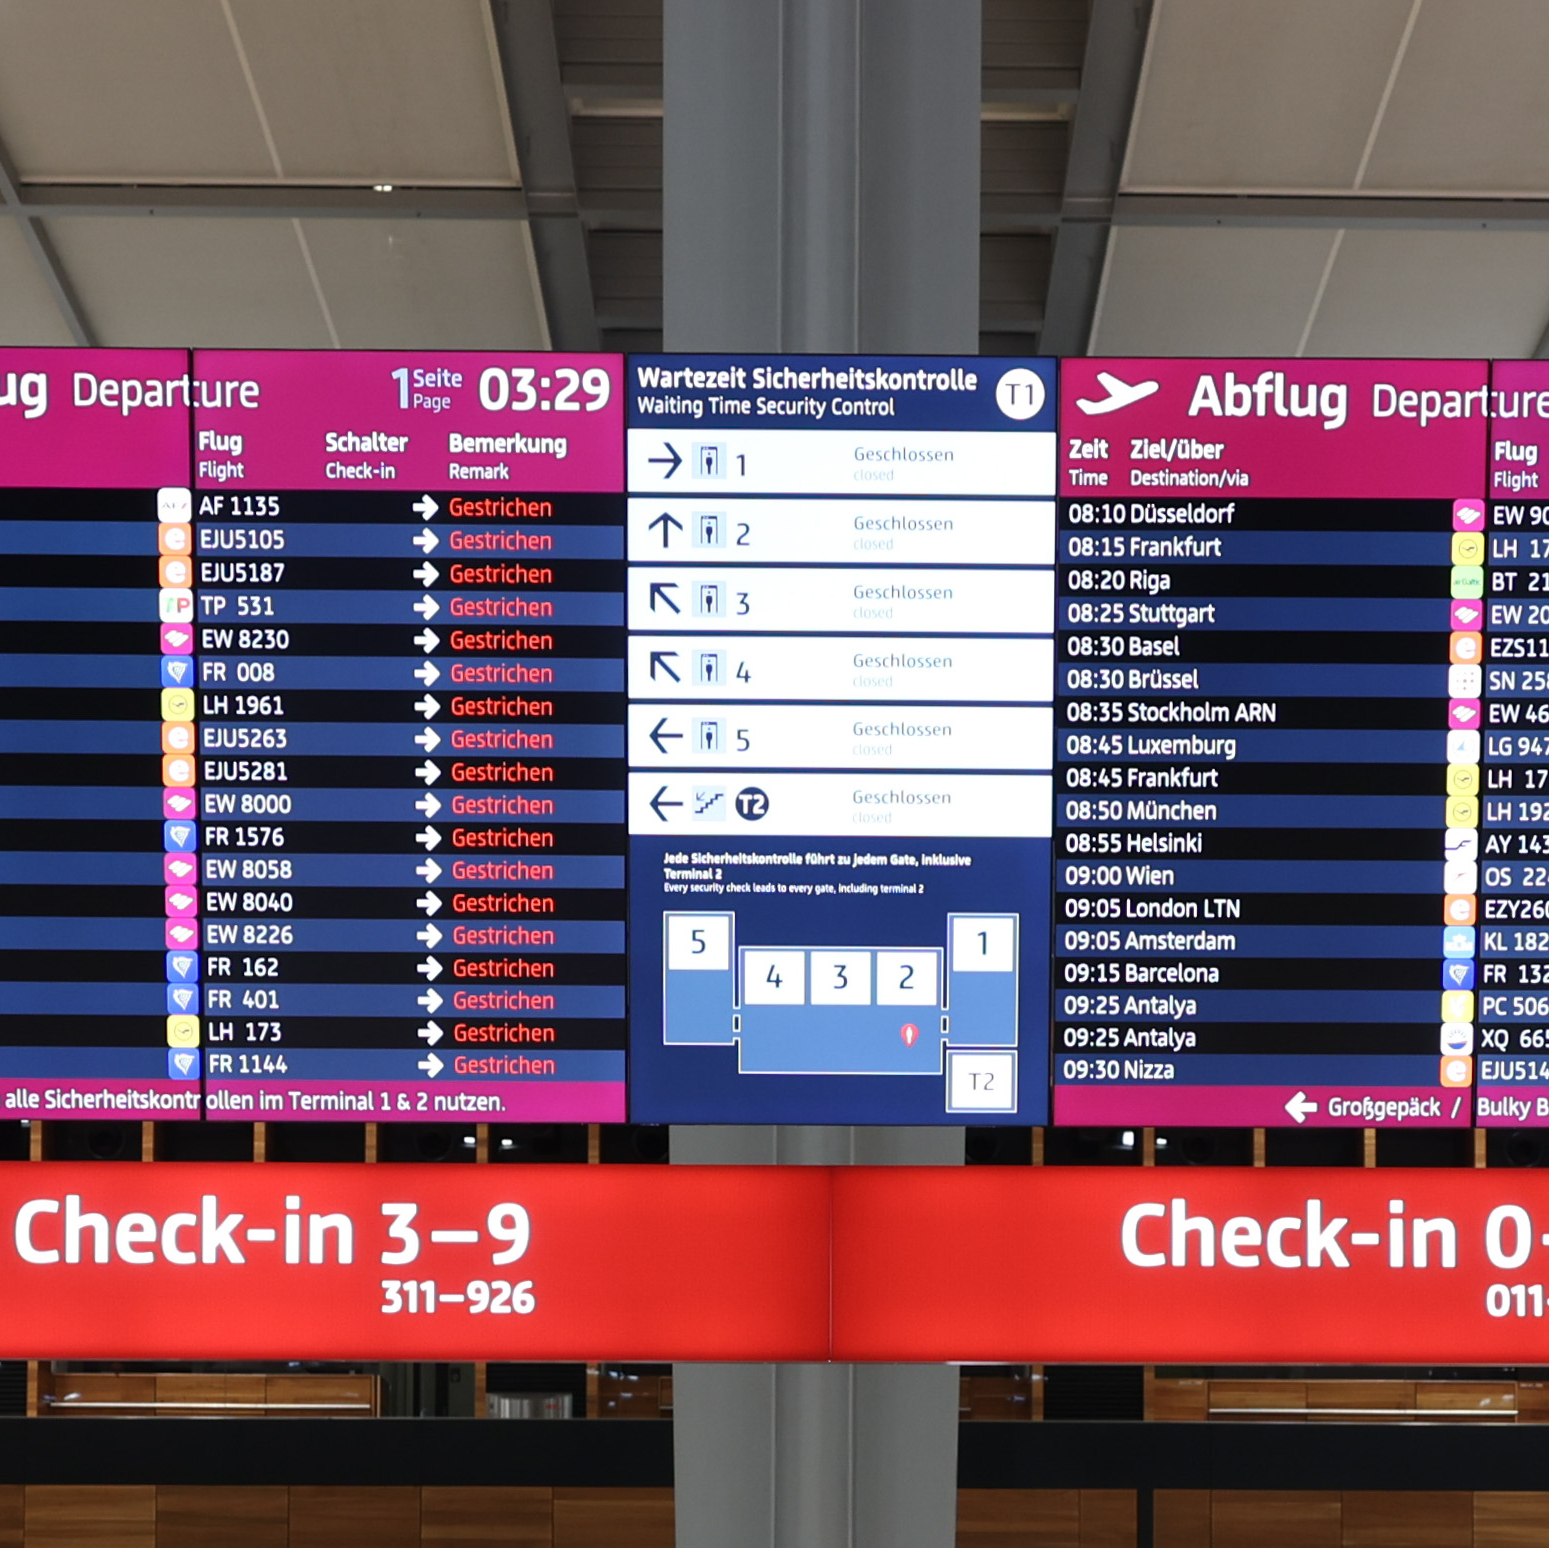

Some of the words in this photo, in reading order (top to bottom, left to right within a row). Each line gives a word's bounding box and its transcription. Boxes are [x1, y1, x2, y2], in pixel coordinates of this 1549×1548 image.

[391, 368, 408, 408] 1
[413, 368, 462, 387] Seite
[638, 366, 746, 388] Wartezeit
[753, 367, 977, 390] Sicherheitskontrolle
[73, 372, 261, 416] Departure
[480, 368, 610, 411] 03:29
[1006, 384, 1033, 405] T1
[1188, 371, 1347, 430] Abflug
[414, 393, 451, 413] Page
[638, 395, 703, 418] Waiting
[708, 396, 751, 414] Time
[757, 397, 826, 419] Security
[832, 397, 894, 416] Control
[199, 430, 242, 456] Flug
[326, 431, 408, 452] Schalter
[450, 433, 567, 458] Bemerkung
[855, 447, 953, 461] Geschlossen
[199, 461, 244, 482] Flight
[326, 461, 395, 478] Check-in
[450, 463, 509, 479] Remark
[737, 454, 745, 476] 1
[199, 496, 224, 515] AF
[231, 496, 279, 516] 1135
[449, 497, 552, 517] Gestrichen
[1067, 702, 1123, 722] 08:35
[1128, 701, 1229, 722] Stockholm
[1235, 703, 1276, 722] ARN
[1490, 704, 1520, 723] EW
[738, 793, 766, 815] T2
[853, 790, 951, 804] Geschlossen
[206, 859, 237, 878] EW
[242, 860, 292, 879] 8058
[452, 861, 554, 880] Gestrichen
[664, 853, 688, 864] Jede
[691, 853, 802, 865] Sicherheitskontrolle
[805, 853, 833, 865] führt
[836, 854, 851, 865] zu
[853, 854, 887, 868] jedem
[890, 854, 919, 868] Gate,
[922, 854, 971, 866] inklusive
[664, 868, 713, 880] Terminal
[715, 869, 722, 880] 2
[664, 883, 688, 895] Every
[690, 883, 724, 895] security
[726, 883, 751, 892] check
[753, 883, 775, 892] leads
[777, 884, 787, 892] to
[789, 885, 813, 895] every
[815, 885, 836, 895] gate,
[838, 884, 878, 895] including
[881, 885, 916, 894] terminal
[918, 885, 924, 894] 2
[1066, 899, 1120, 917] 09:05
[1127, 898, 1197, 918] London
[1204, 899, 1240, 918] LTN
[692, 930, 705, 954] 5
[978, 932, 986, 955] 1
[767, 965, 782, 988] 4
[834, 965, 847, 989] 3
[900, 965, 913, 989] 2
[210, 1054, 232, 1073] FR
[239, 1055, 287, 1073] 1144
[454, 1055, 556, 1075] Gestrichen
[969, 1073, 994, 1090] T2
[5, 1088, 40, 1108] alle
[260, 1090, 283, 1110] im
[288, 1091, 374, 1110] Terminal
[381, 1092, 391, 1110] 1
[397, 1093, 411, 1110] &
[417, 1092, 428, 1111] 2
[435, 1093, 505, 1111] nutzen.
[1329, 1097, 1441, 1121] Großgepäck
[1451, 1097, 1461, 1118] /
[1478, 1097, 1531, 1121] Bulky
[15, 1195, 352, 1264] Check-in
[1122, 1198, 1456, 1268] Check-in
